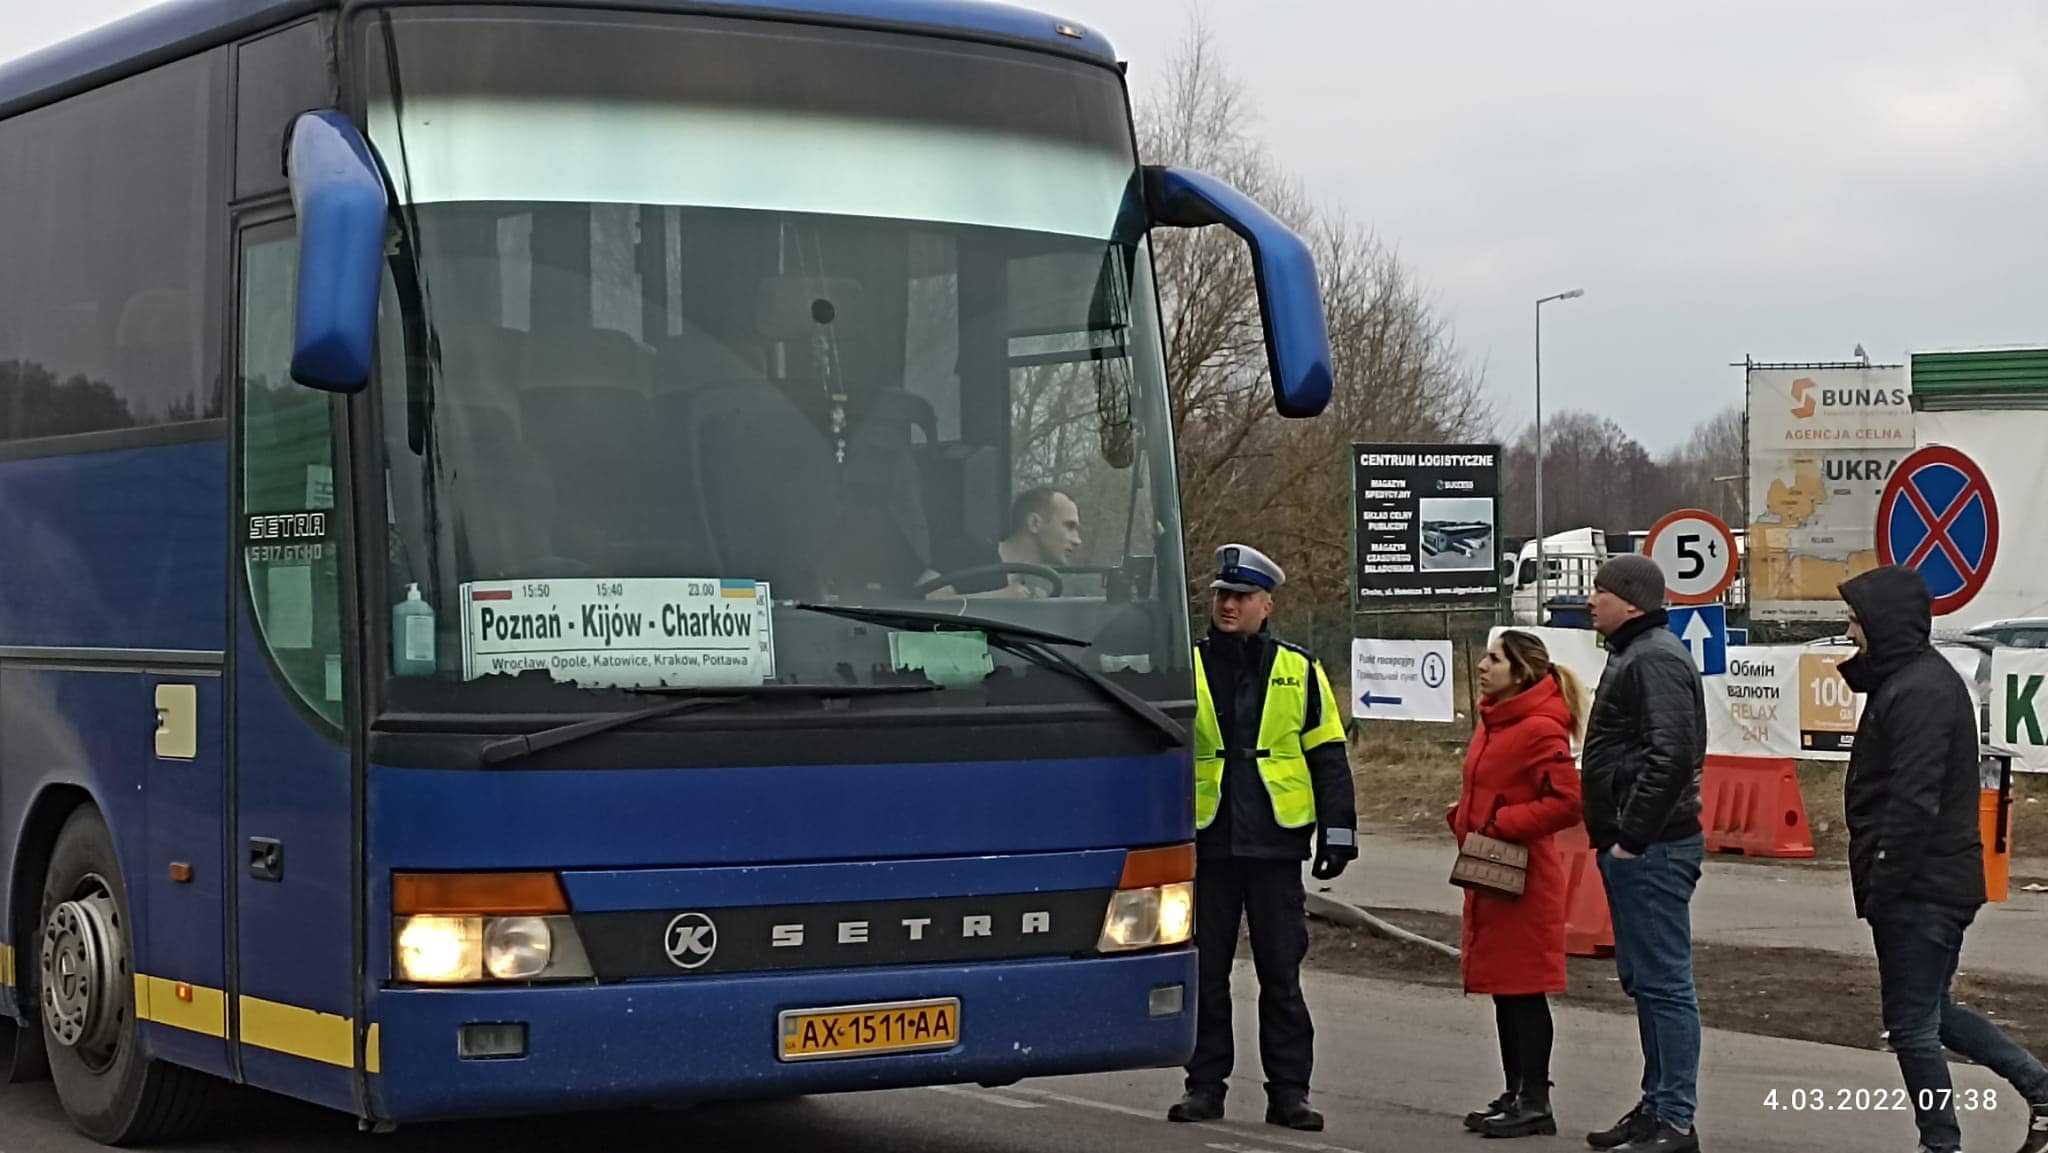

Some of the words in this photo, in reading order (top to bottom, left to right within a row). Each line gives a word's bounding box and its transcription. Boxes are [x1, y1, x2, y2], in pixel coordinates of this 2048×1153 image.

[1785, 428, 1851, 440] AGENCJA
[1855, 428, 1902, 440] CELNA
[1360, 454, 1416, 466] CENTRUM
[1418, 454, 1494, 467] LOGISTYCZNE
[250, 512, 326, 539] SETRA
[522, 584, 550, 598] 15:50
[596, 583, 623, 597] 15:40
[481, 605, 561, 641] Poznań
[581, 603, 641, 646] Kijów
[662, 603, 751, 637] Charków
[1730, 659, 1775, 677] Обмін
[1727, 685, 1780, 699] валюти
[1810, 677, 1853, 707] 100
[1731, 702, 1778, 720] RELAX
[2006, 673, 2048, 746] K
[1742, 724, 1768, 742] 24H
[772, 911, 1050, 947] SETRA
